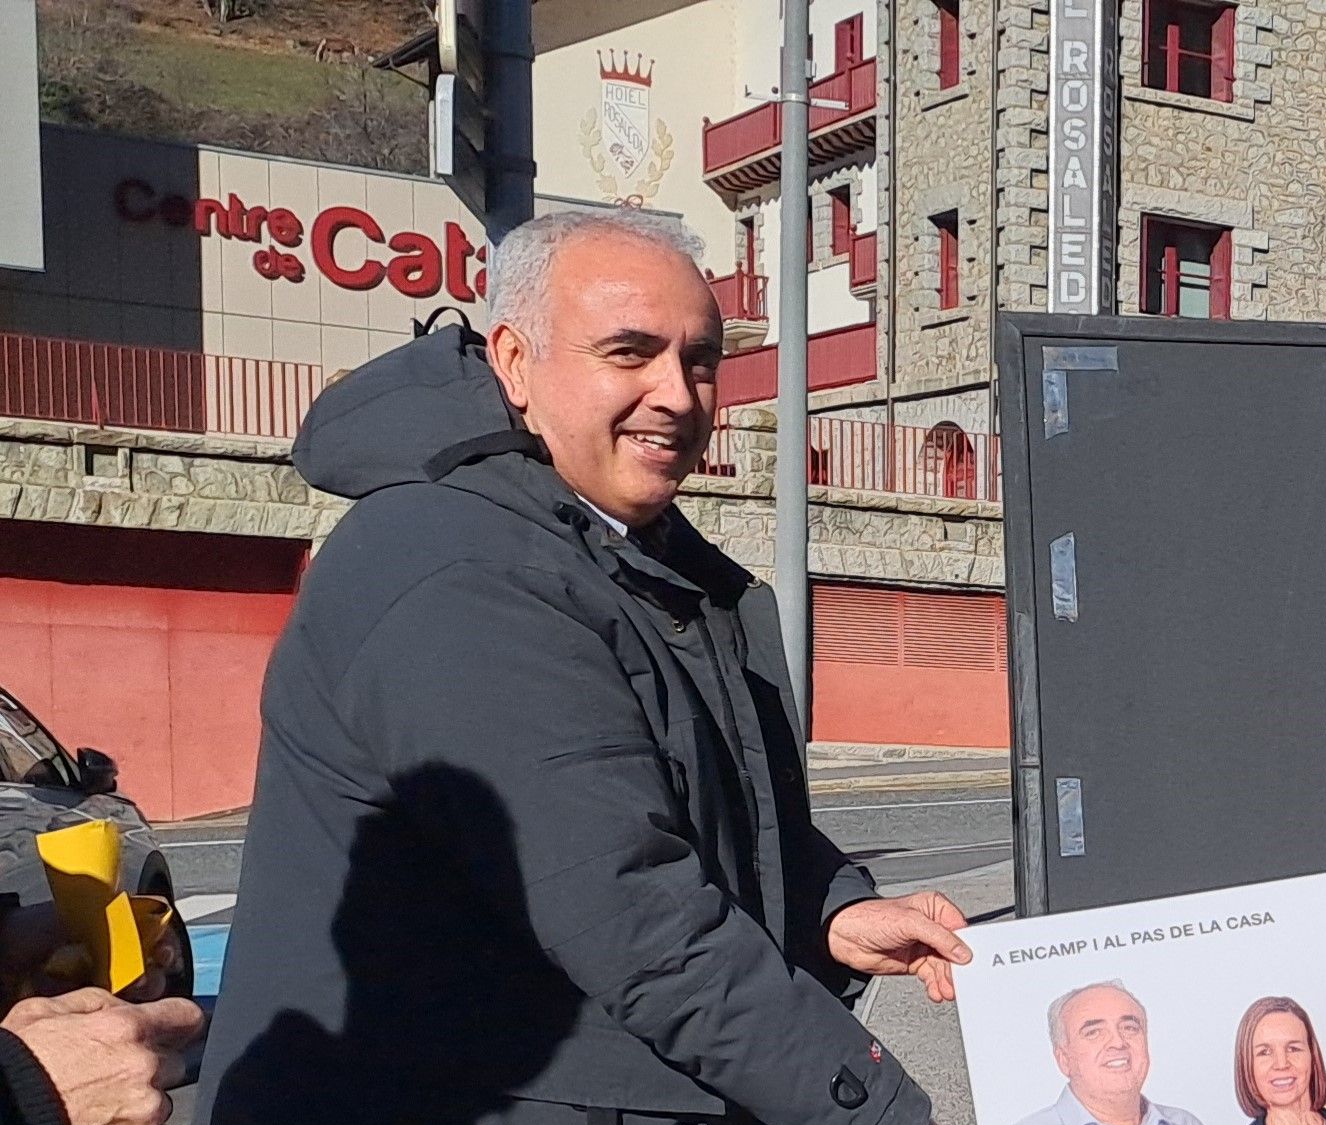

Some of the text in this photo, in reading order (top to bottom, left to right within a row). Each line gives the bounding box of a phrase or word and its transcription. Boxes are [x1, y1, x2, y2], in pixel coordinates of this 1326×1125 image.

[605, 84, 646, 106] HOTEL
[604, 101, 644, 154] ROSALEDA
[1060, 40, 1088, 314] ROSALED
[114, 177, 304, 247] Centre
[252, 246, 306, 284] de
[311, 206, 488, 304] Cat
[992, 911, 1276, 967] A ENCAMP I AL PAS DE LA CASA
